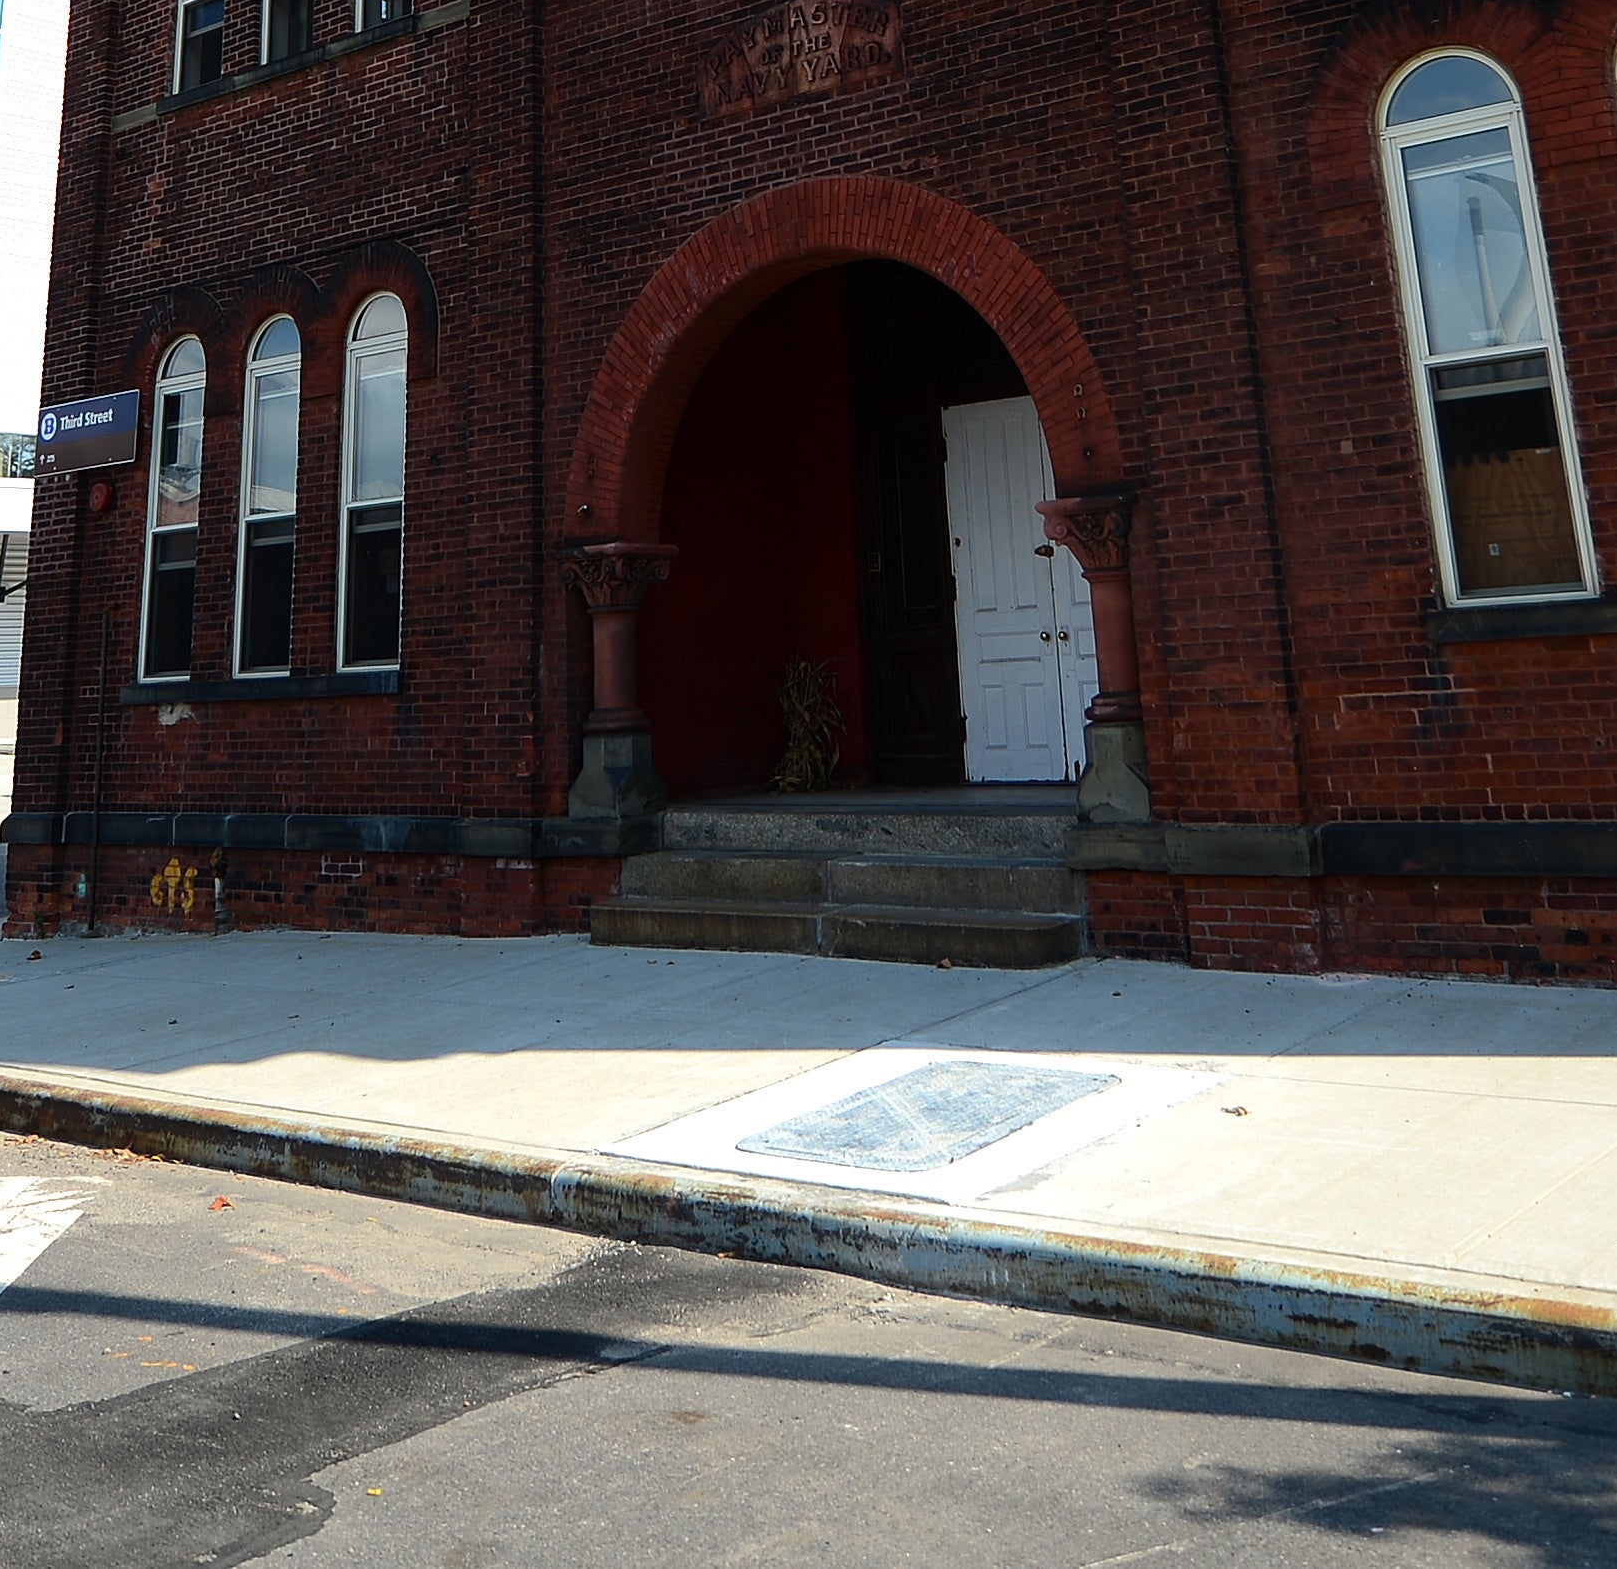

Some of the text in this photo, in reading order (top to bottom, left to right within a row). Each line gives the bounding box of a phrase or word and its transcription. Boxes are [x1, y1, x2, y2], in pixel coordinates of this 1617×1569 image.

[707, 3, 889, 79] PAYMASTER
[760, 32, 832, 65] OF THE
[714, 65, 793, 106] NAVY
[60, 413, 83, 430] Third
[84, 408, 113, 426] Street
